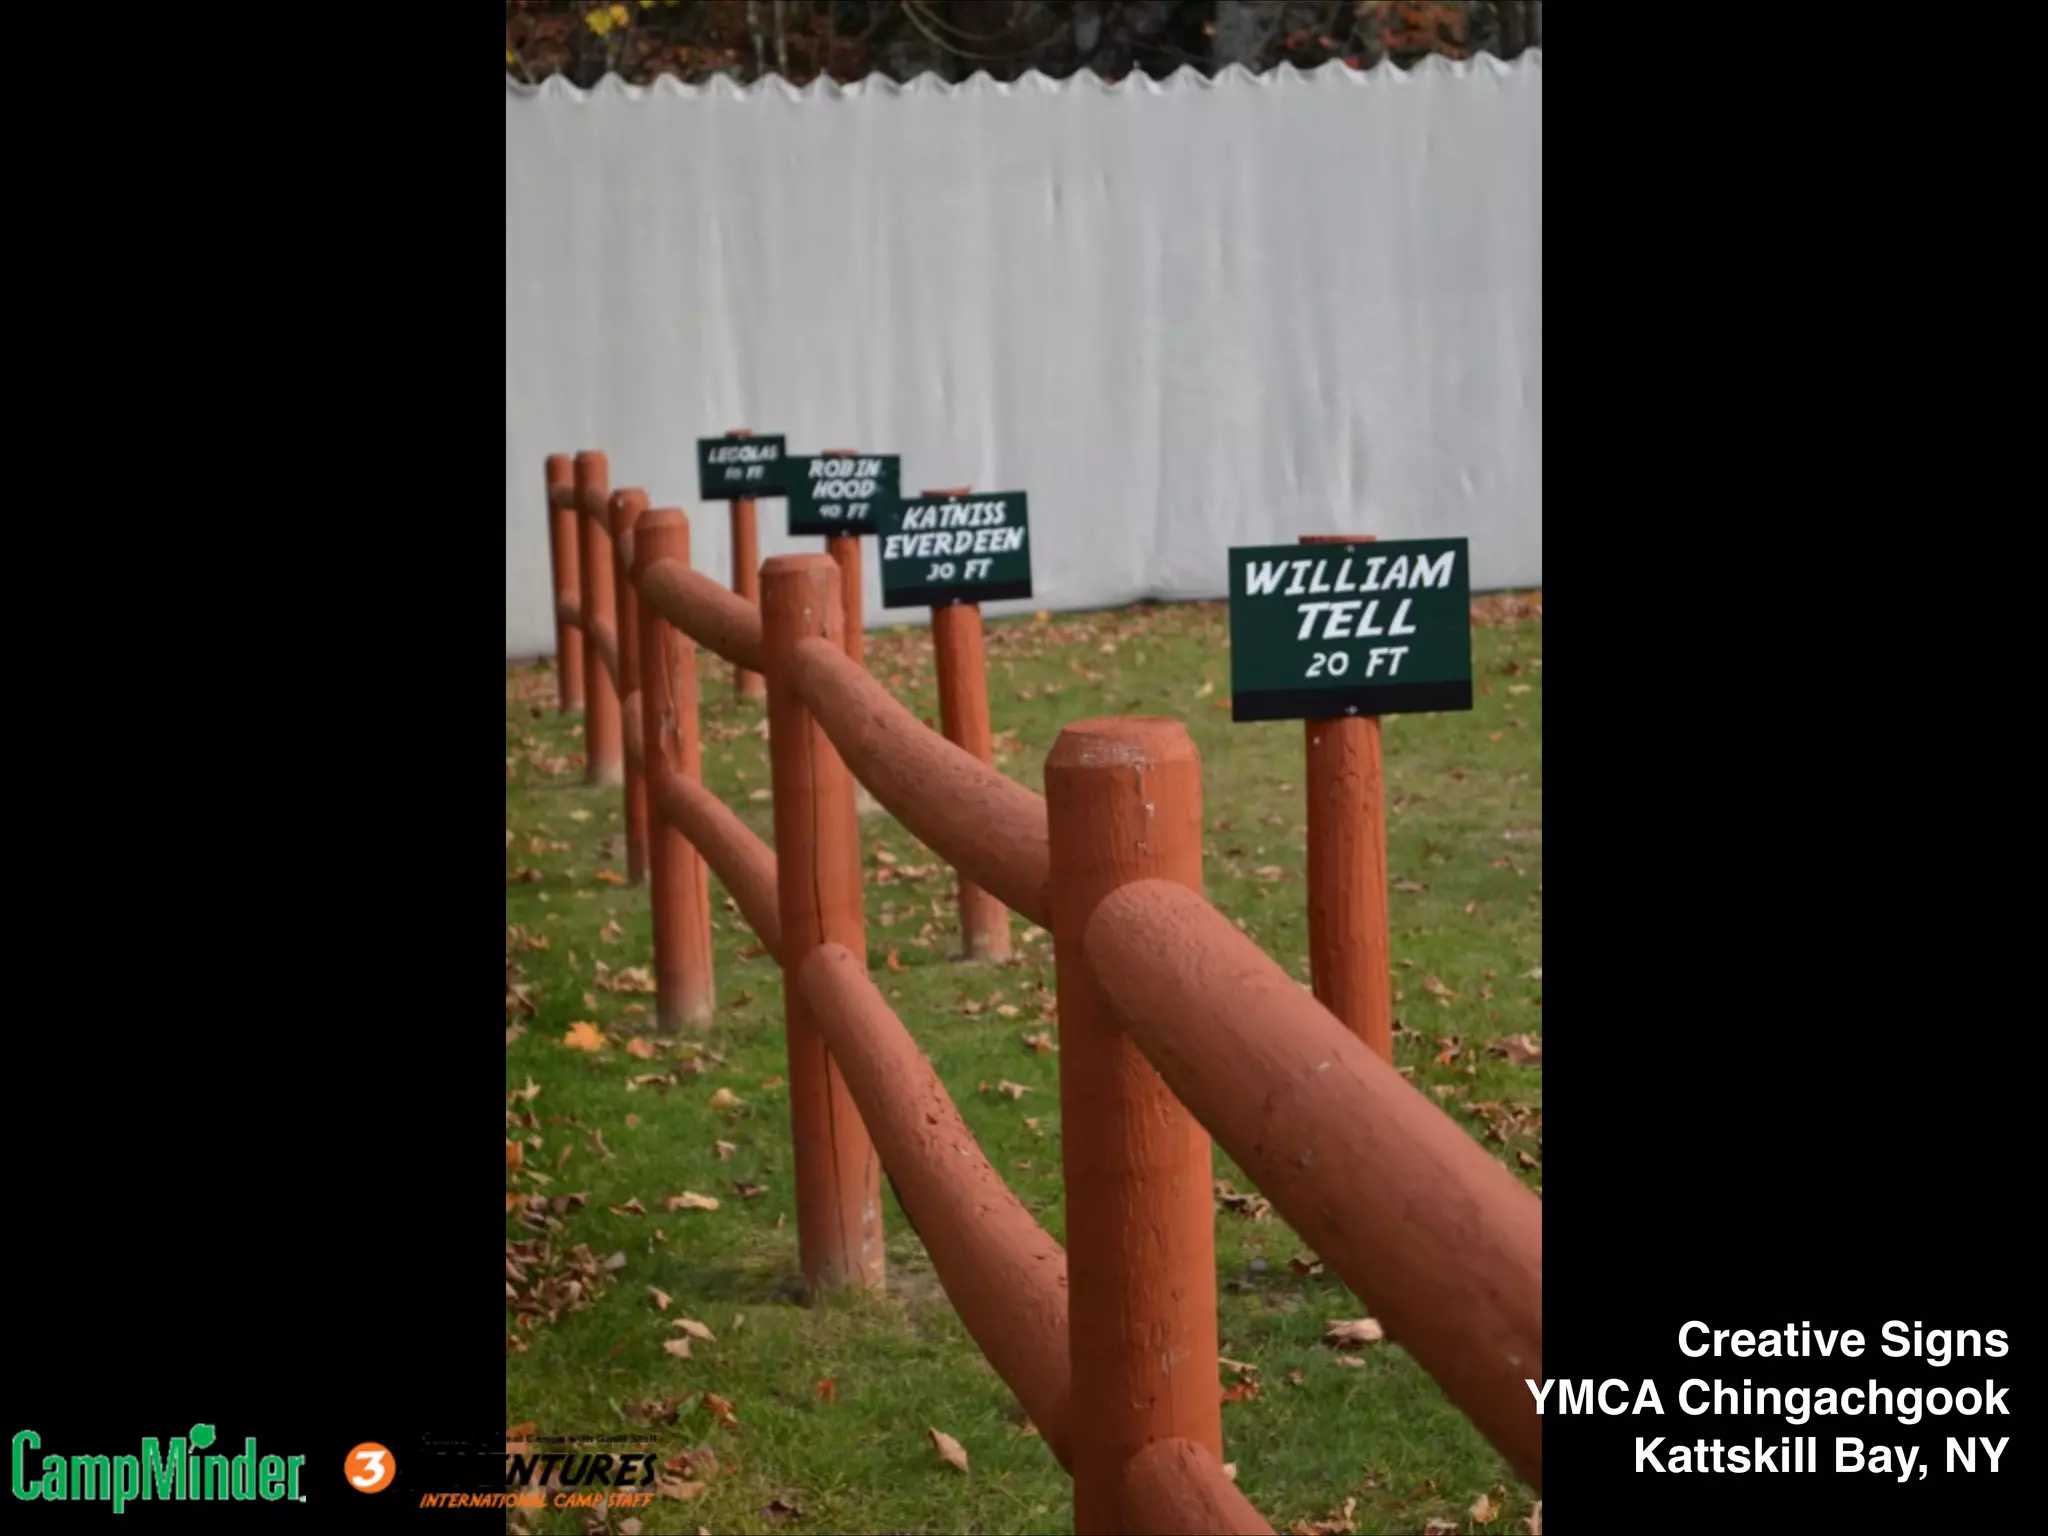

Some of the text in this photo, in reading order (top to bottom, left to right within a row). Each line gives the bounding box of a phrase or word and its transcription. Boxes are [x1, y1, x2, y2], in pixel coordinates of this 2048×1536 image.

[808, 459, 882, 478] ROBIN
[812, 479, 876, 499] HOOD
[819, 502, 870, 519] 40 FT
[902, 501, 1006, 530] KATNISS
[884, 526, 1025, 560] EVERDEEN
[964, 558, 992, 580] FT
[1245, 551, 1456, 596] WILLIAM
[1297, 598, 1416, 641] TELL
[1305, 646, 1409, 678] 20 FT
